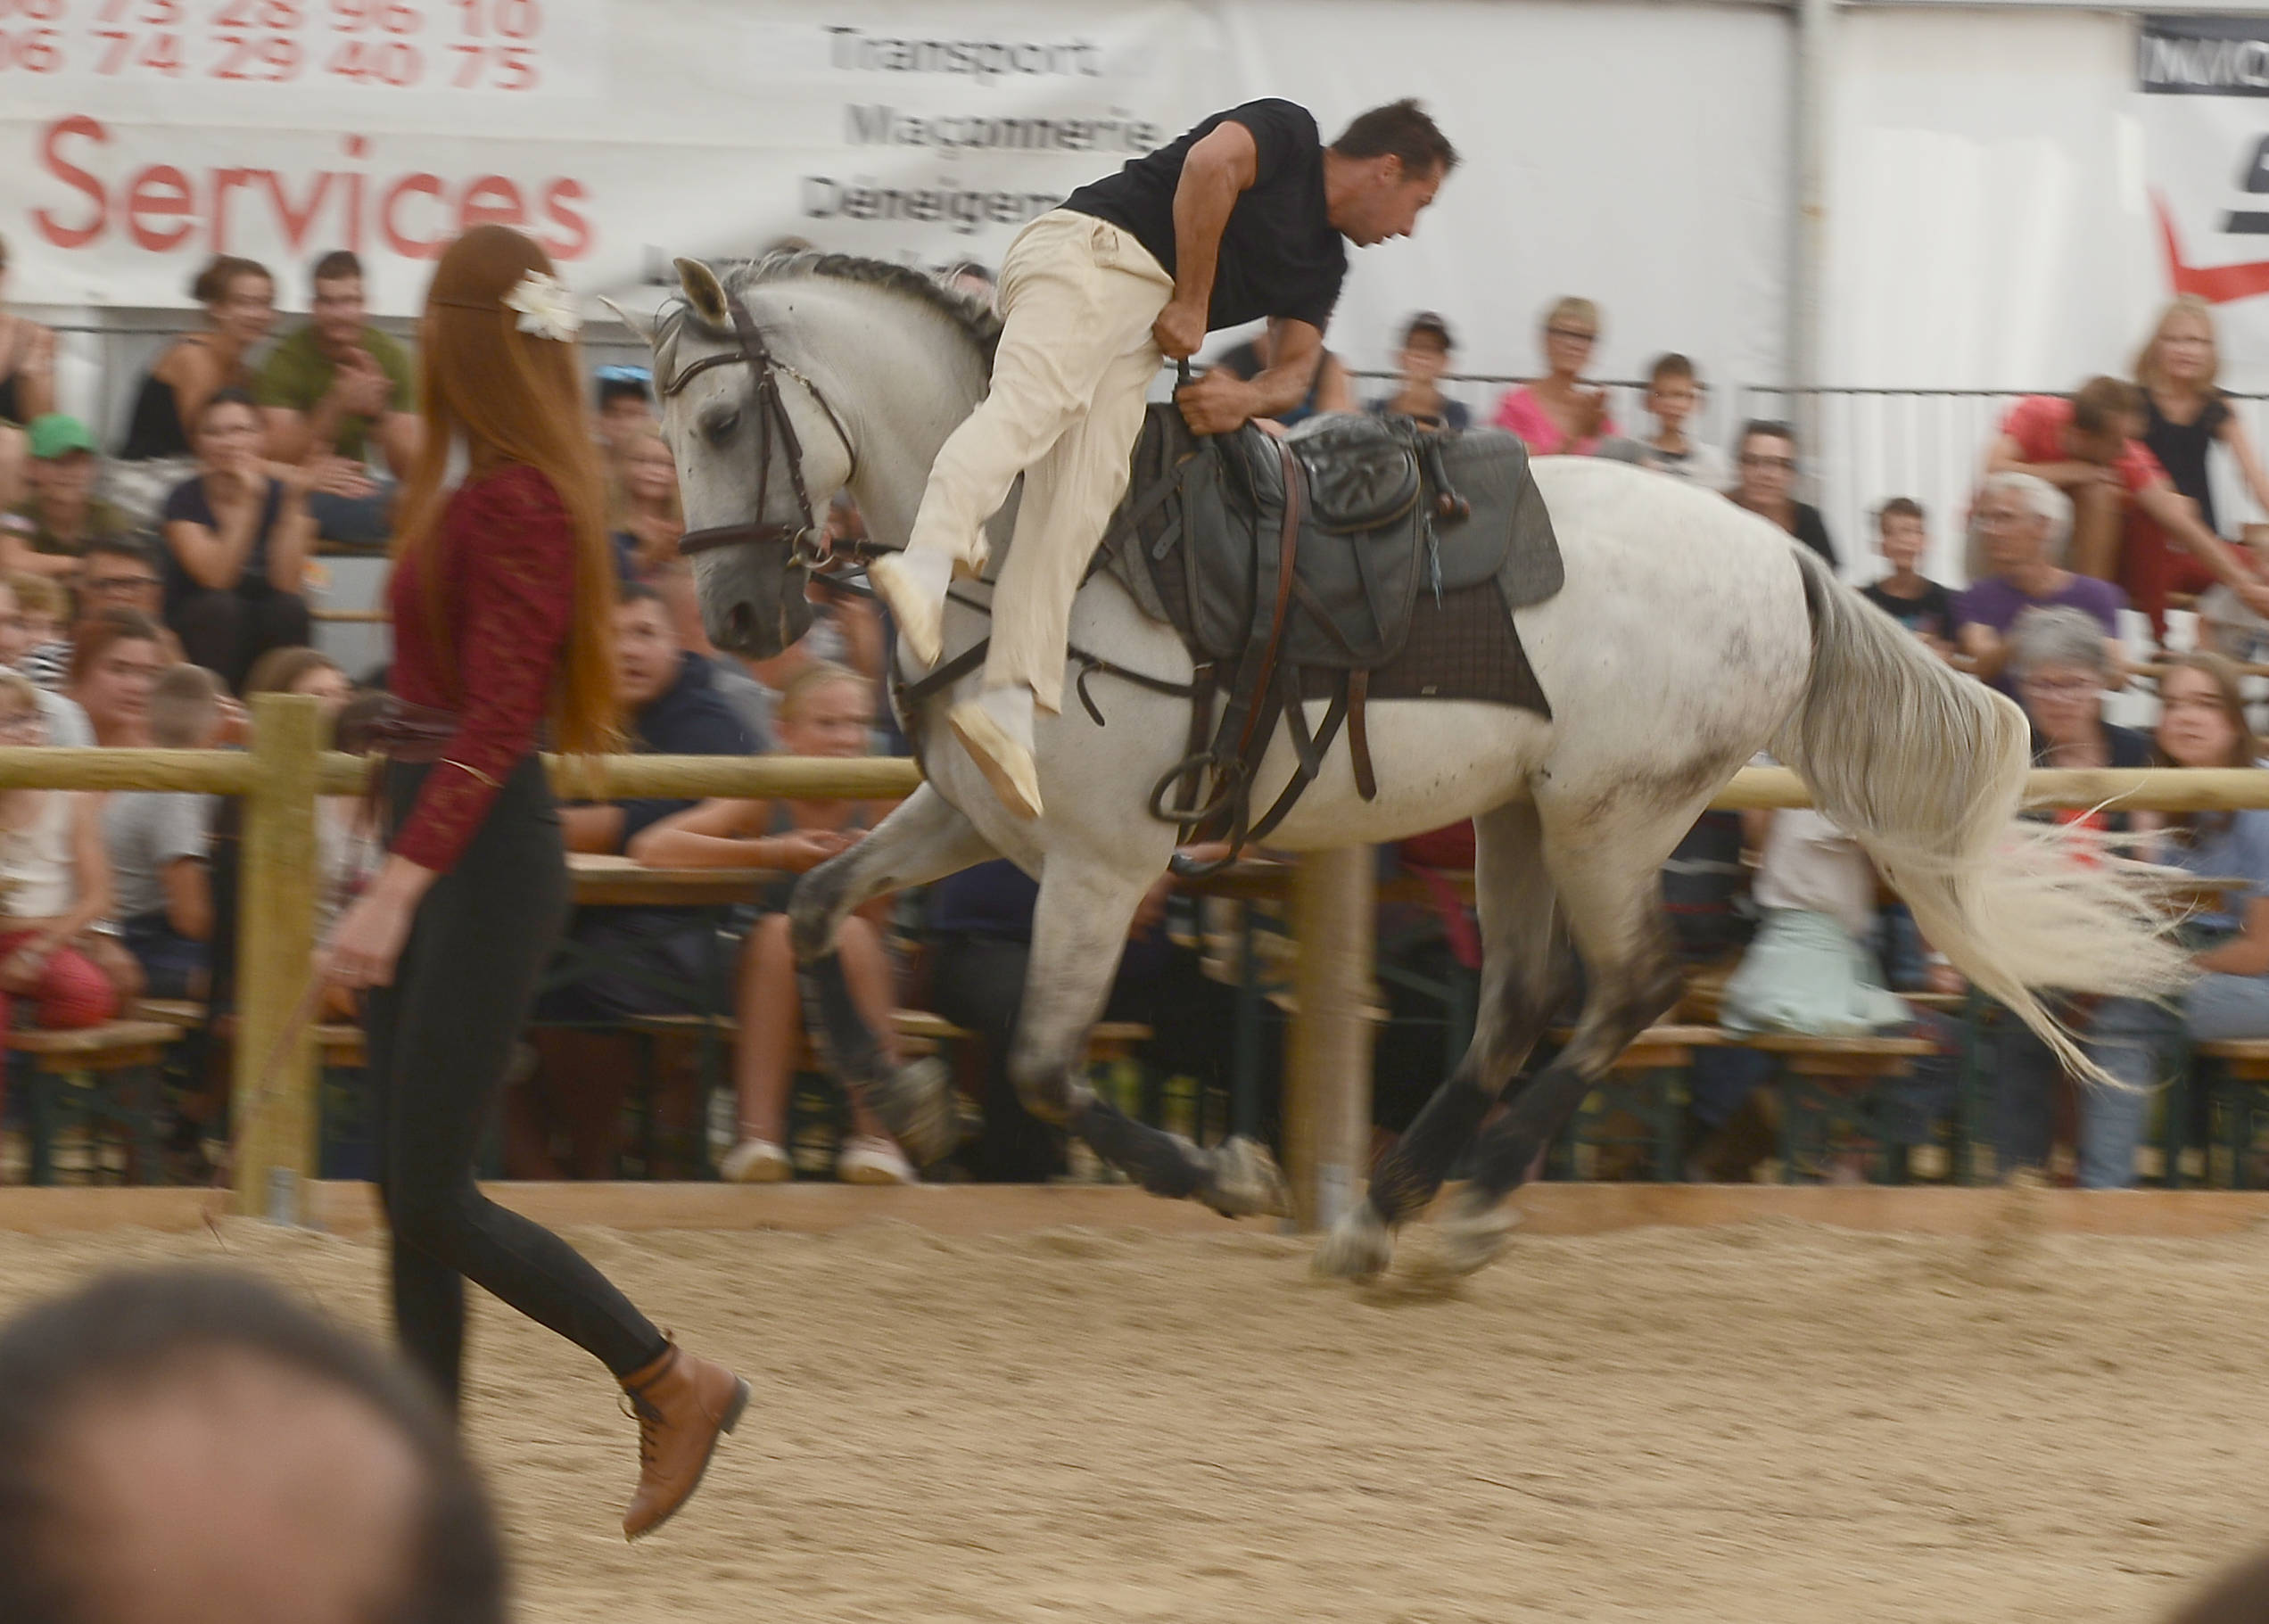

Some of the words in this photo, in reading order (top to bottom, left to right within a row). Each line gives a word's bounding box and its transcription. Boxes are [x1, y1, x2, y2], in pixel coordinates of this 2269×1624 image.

[91, 29, 186, 78] 74
[207, 34, 306, 83] 29
[326, 40, 425, 87] 40
[444, 45, 542, 91] 75
[821, 24, 1106, 87] Transport
[843, 103, 1161, 159] Maçonnerie
[30, 114, 593, 260] Services
